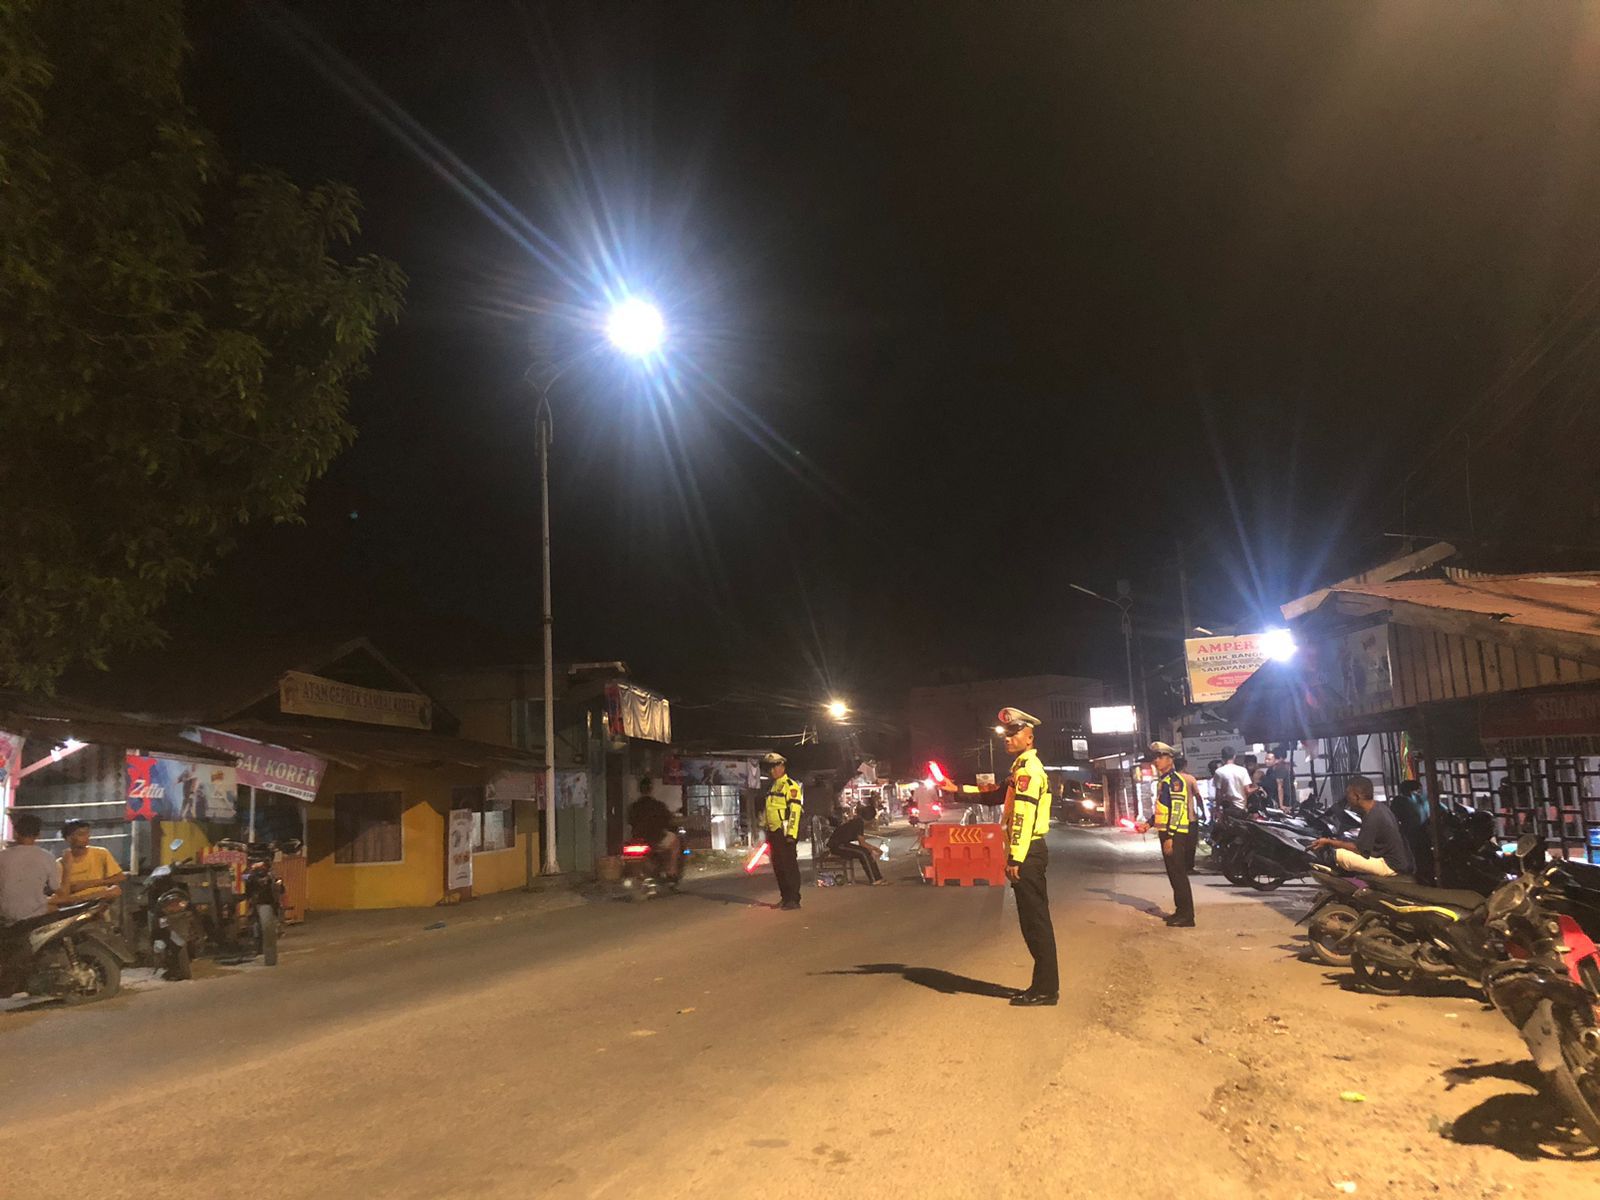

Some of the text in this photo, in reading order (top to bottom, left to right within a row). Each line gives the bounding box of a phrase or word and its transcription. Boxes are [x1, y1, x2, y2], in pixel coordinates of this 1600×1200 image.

[1197, 640, 1260, 654] AMPER
[1197, 654, 1229, 662] LUBUK
[1201, 664, 1246, 673] SARAPAN
[265, 759, 318, 787] KOREK
[1011, 813, 1025, 846] POLISI
